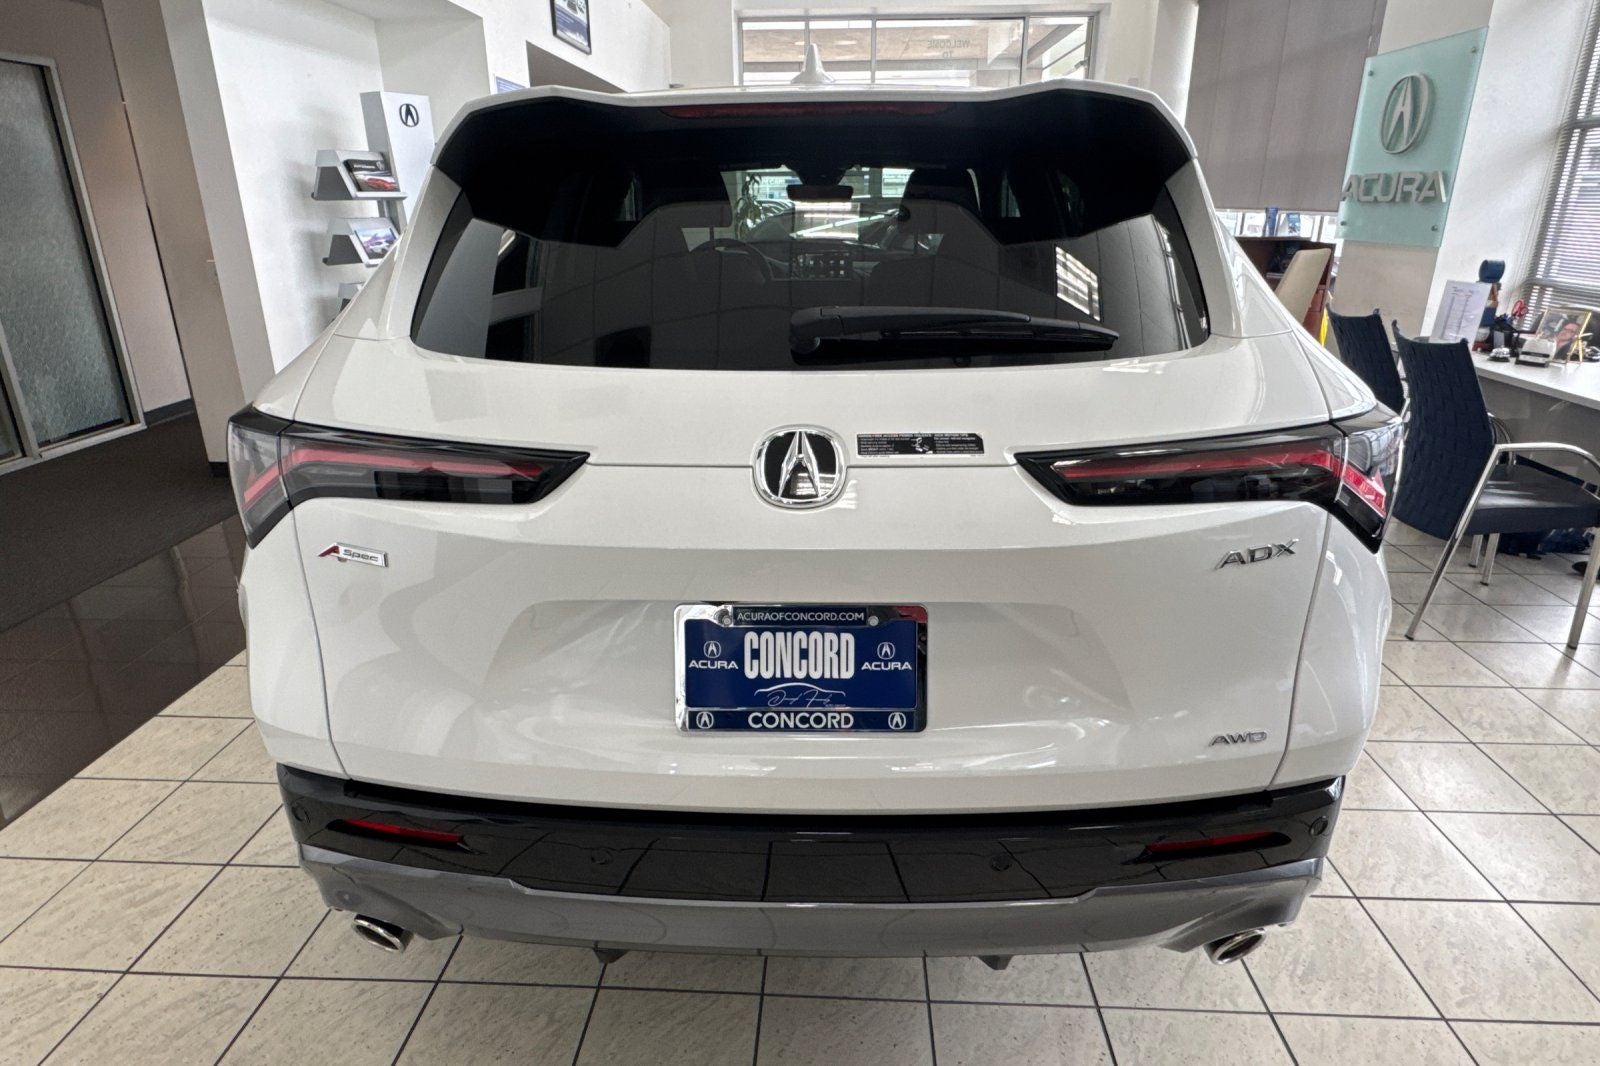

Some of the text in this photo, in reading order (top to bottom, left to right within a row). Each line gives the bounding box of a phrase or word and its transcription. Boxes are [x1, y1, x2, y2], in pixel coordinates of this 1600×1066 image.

[1340, 169, 1447, 203] ACURA
[1214, 538, 1300, 569] ADX
[737, 612, 865, 622] ACURAOFCONCORD.COM
[744, 631, 856, 680] CONCORD
[688, 659, 739, 670] ACURA
[861, 661, 913, 671] ACURA
[747, 712, 855, 729] CONCORD
[1208, 731, 1268, 747] AWD
